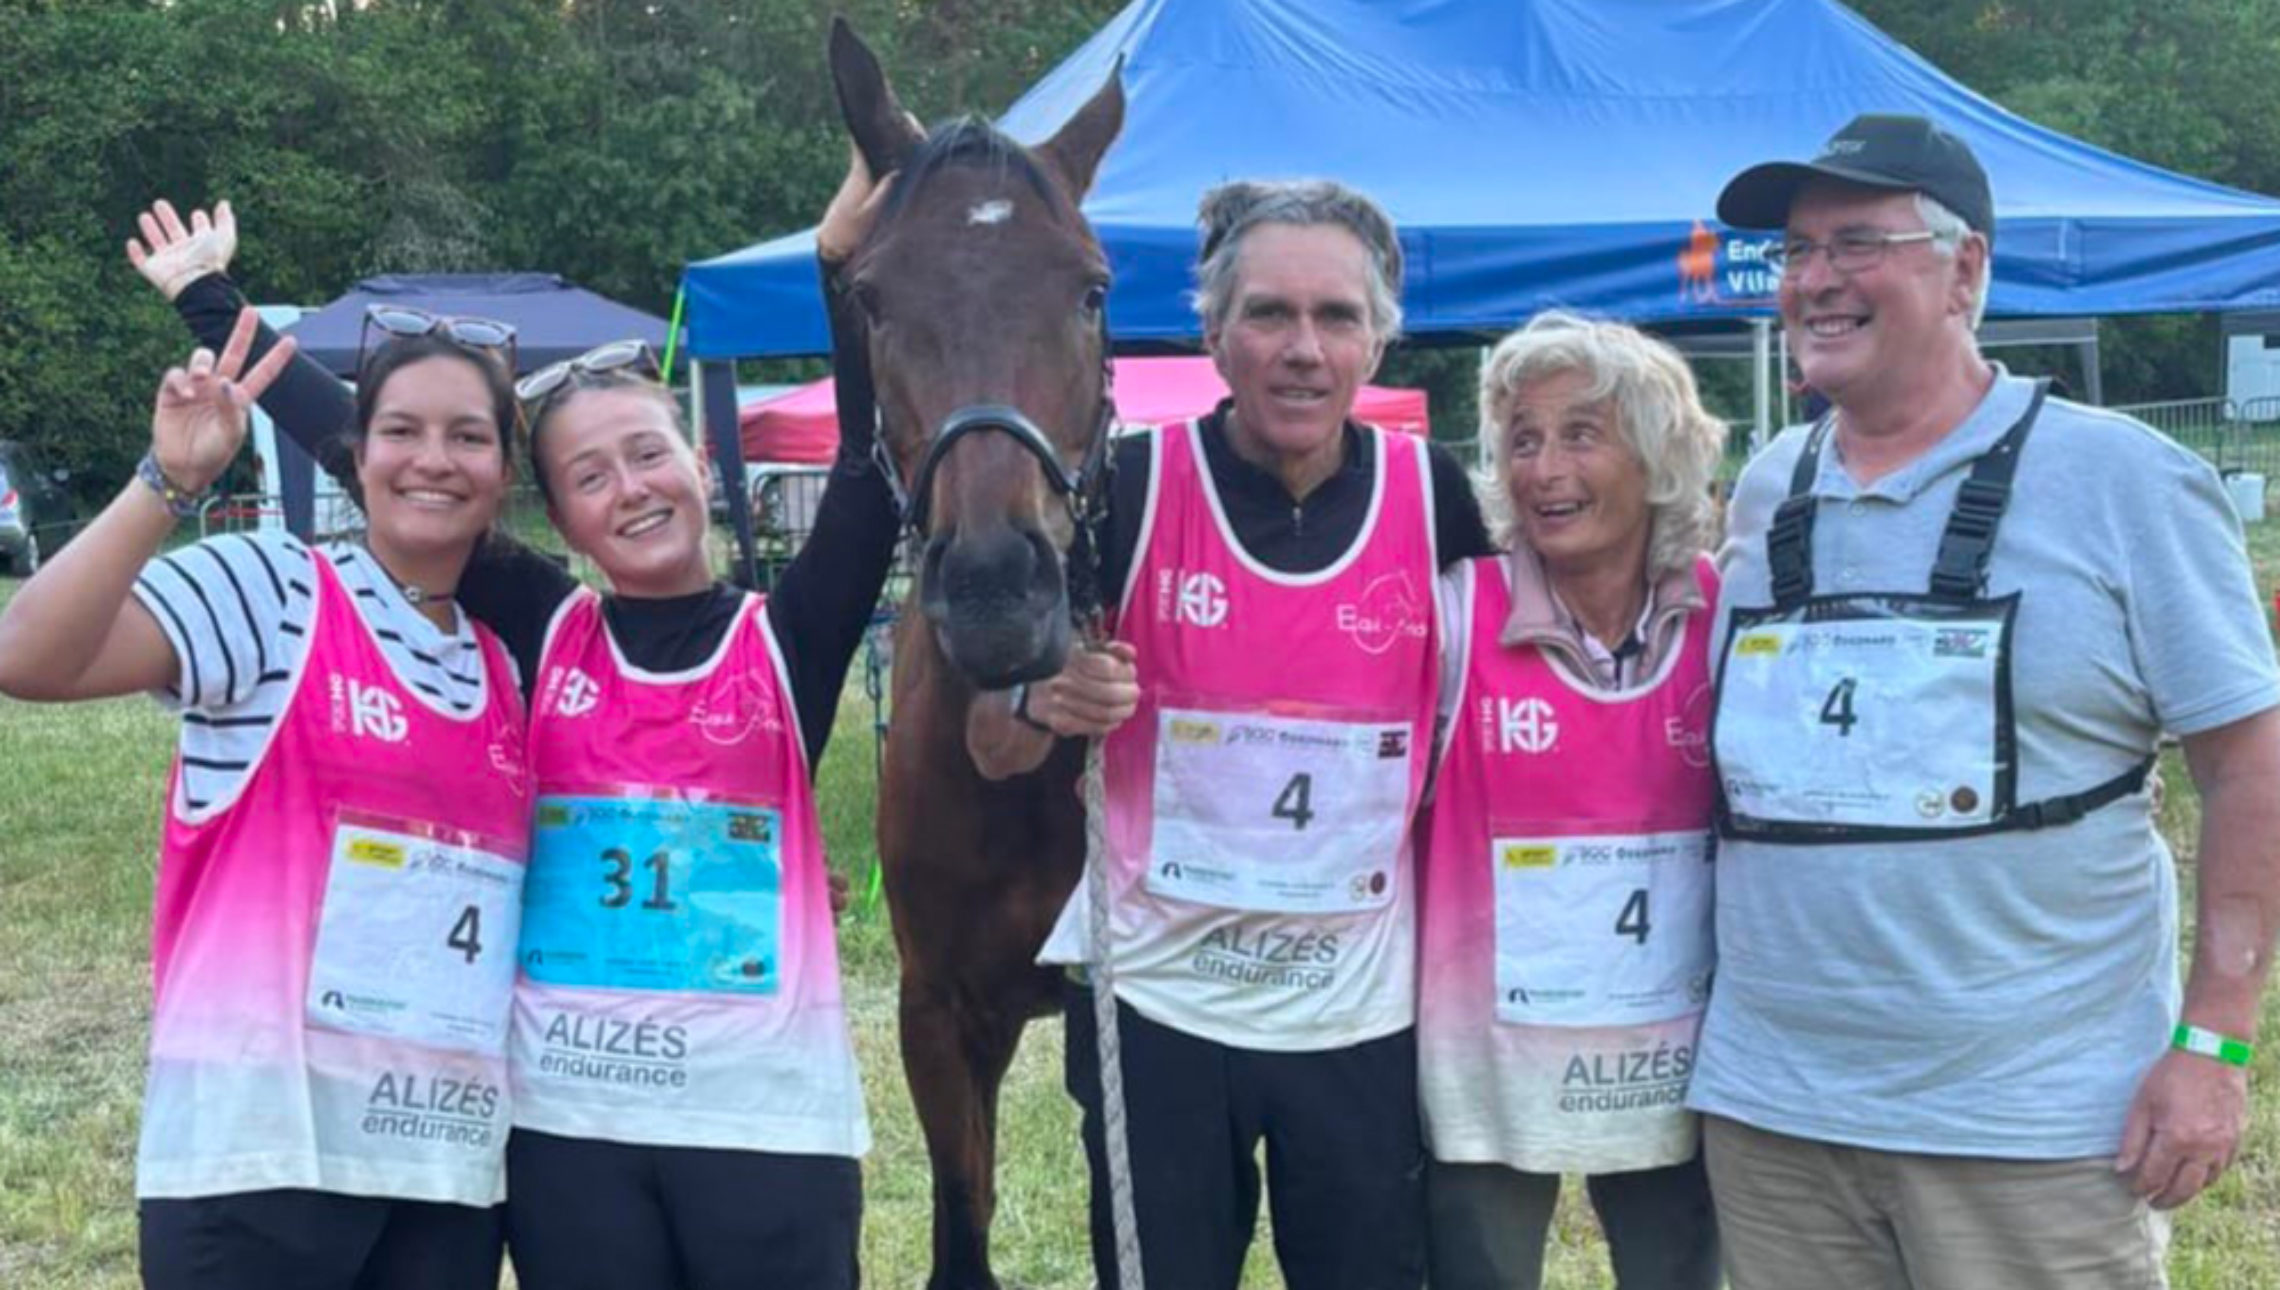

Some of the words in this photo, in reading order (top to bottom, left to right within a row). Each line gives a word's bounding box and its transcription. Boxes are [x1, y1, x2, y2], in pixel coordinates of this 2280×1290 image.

[1819, 677, 1859, 737] 4
[1271, 773, 1315, 830] 4
[599, 847, 677, 910] 31
[447, 904, 482, 964] 4
[1614, 889, 1651, 945] 4
[1199, 925, 1339, 963] ALIZÉS
[1192, 953, 1335, 990] endurance
[545, 1012, 688, 1060] ALIZÉS
[539, 1053, 688, 1088] endurance
[1562, 1041, 1691, 1087] ALIZÉS
[369, 1071, 499, 1120] ALIZÉS
[361, 1114, 493, 1148] endurance
